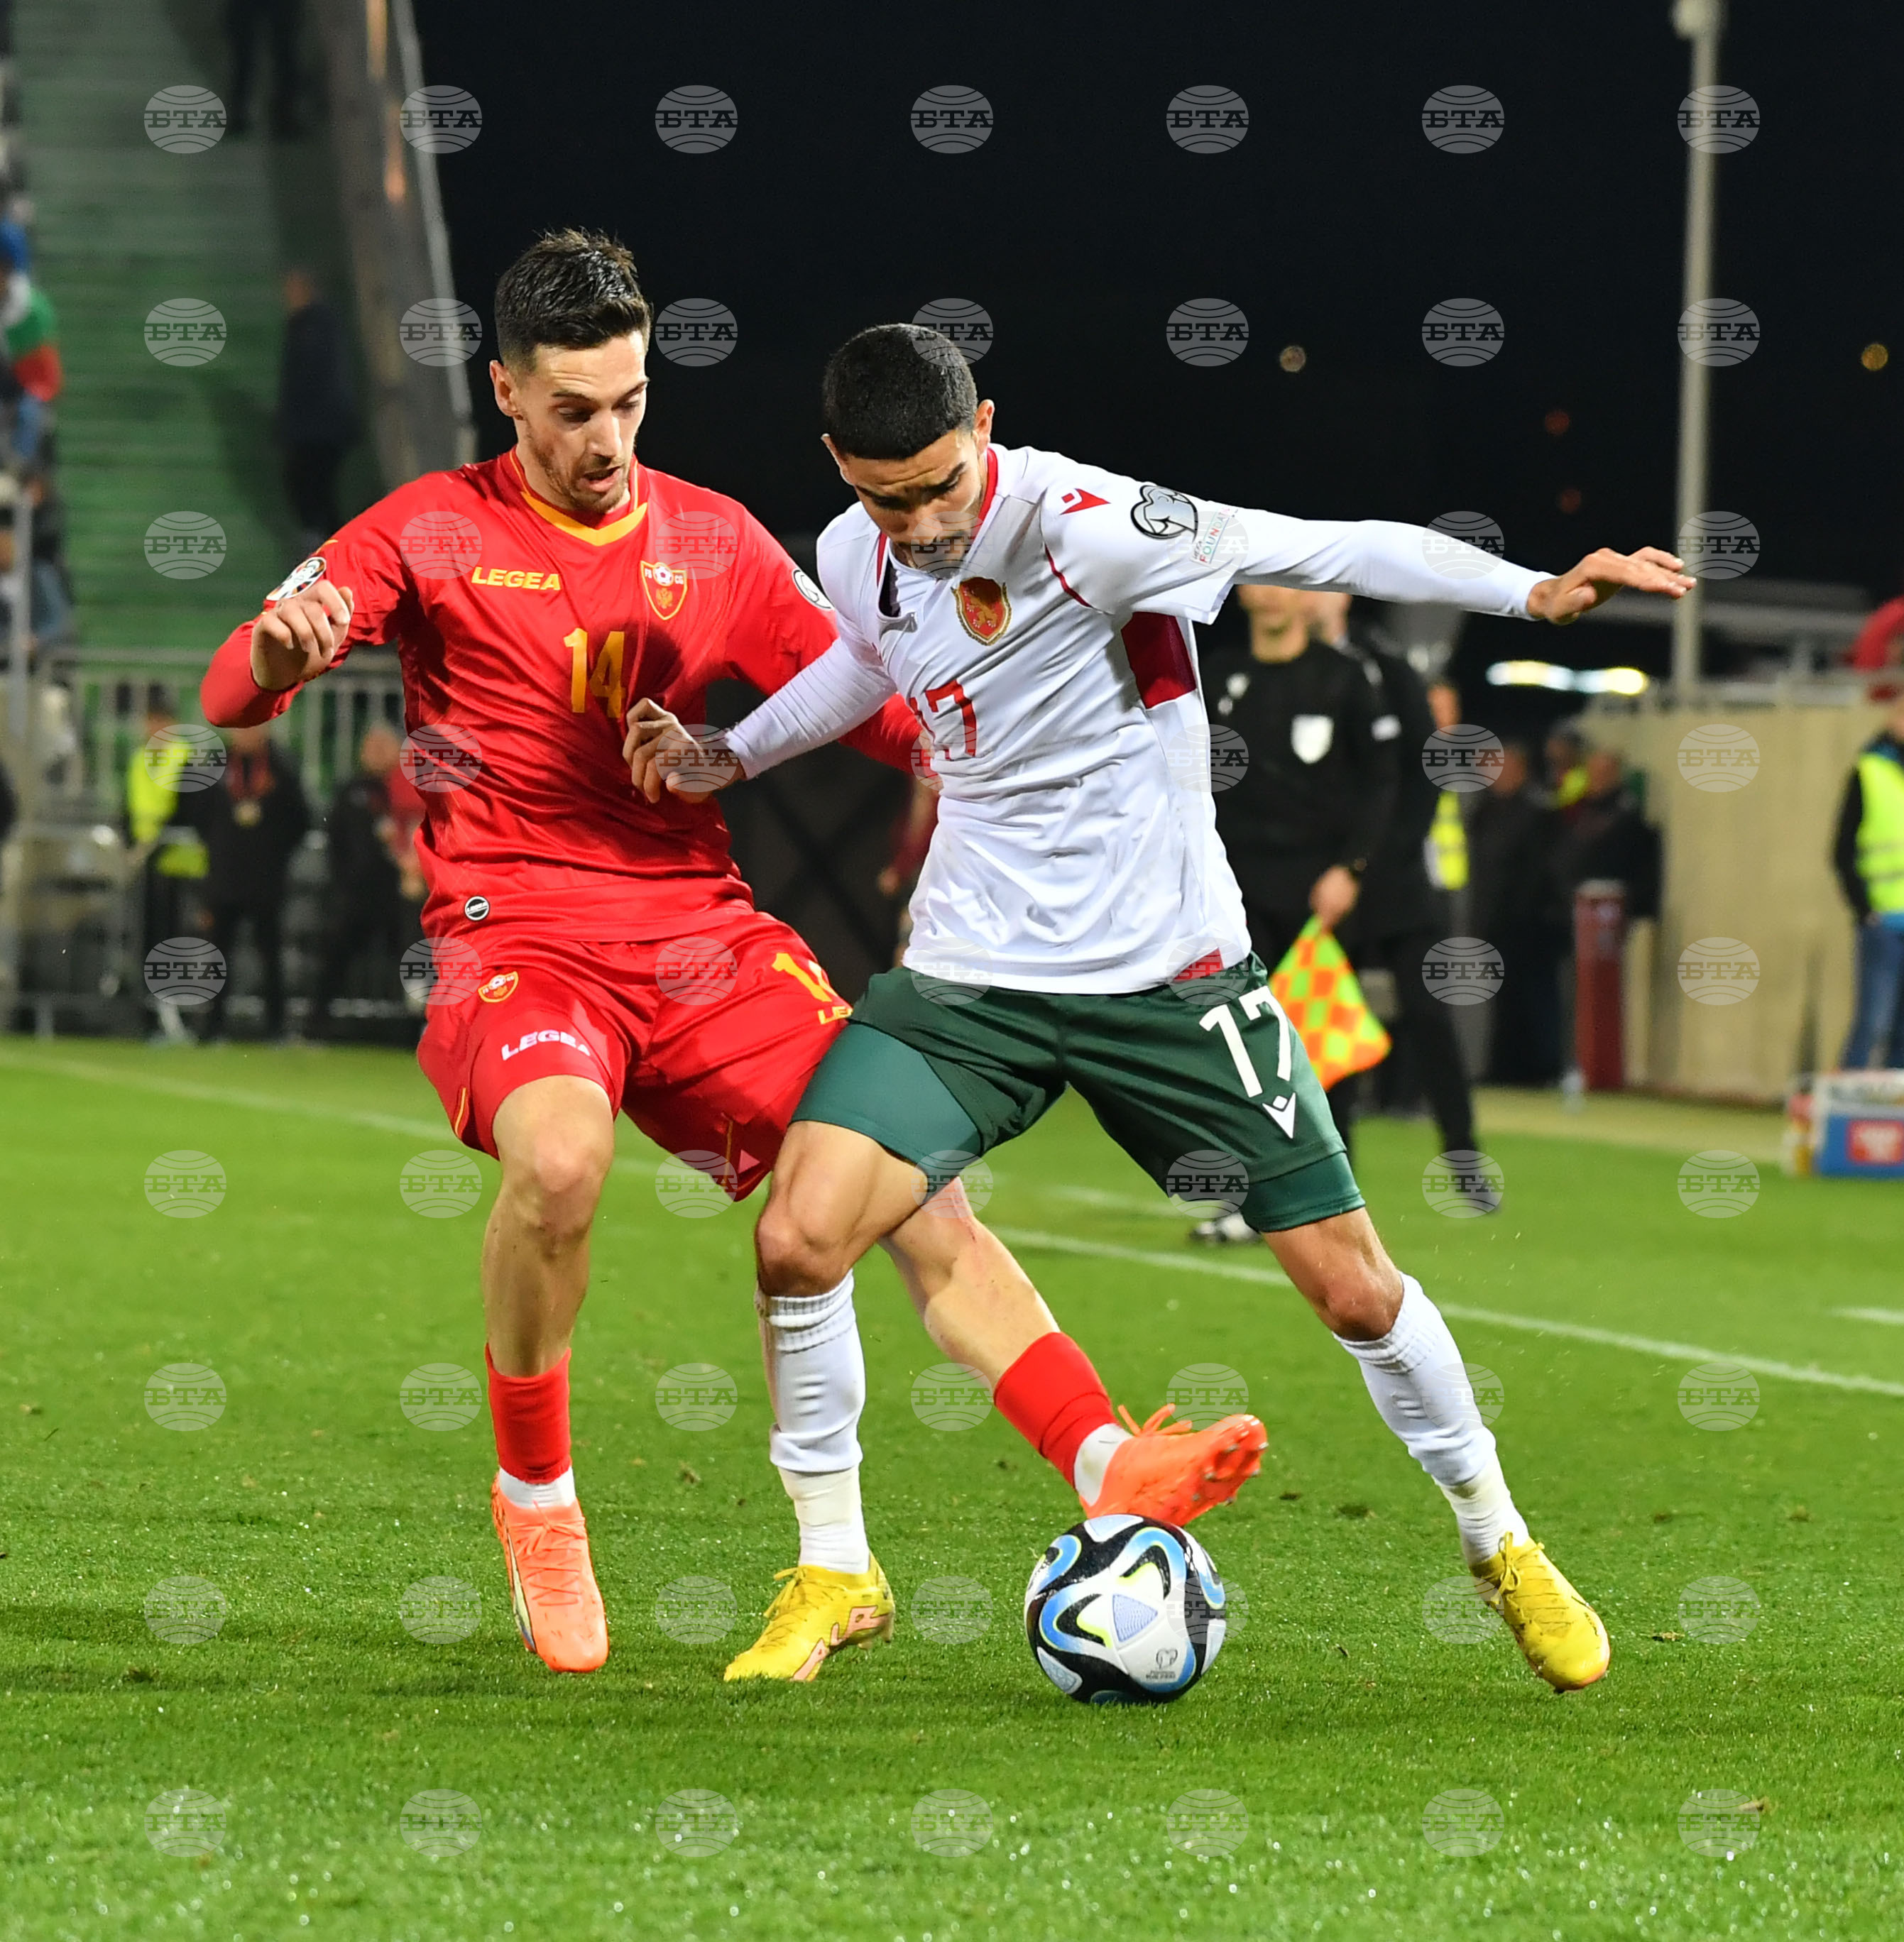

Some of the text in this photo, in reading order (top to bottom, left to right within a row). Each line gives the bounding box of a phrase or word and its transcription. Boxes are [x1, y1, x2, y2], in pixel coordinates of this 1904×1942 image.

[471, 566, 561, 591] LEGEA
[564, 627, 625, 718] 14
[818, 1006, 853, 1024] LE
[1199, 985, 1292, 1098] 17
